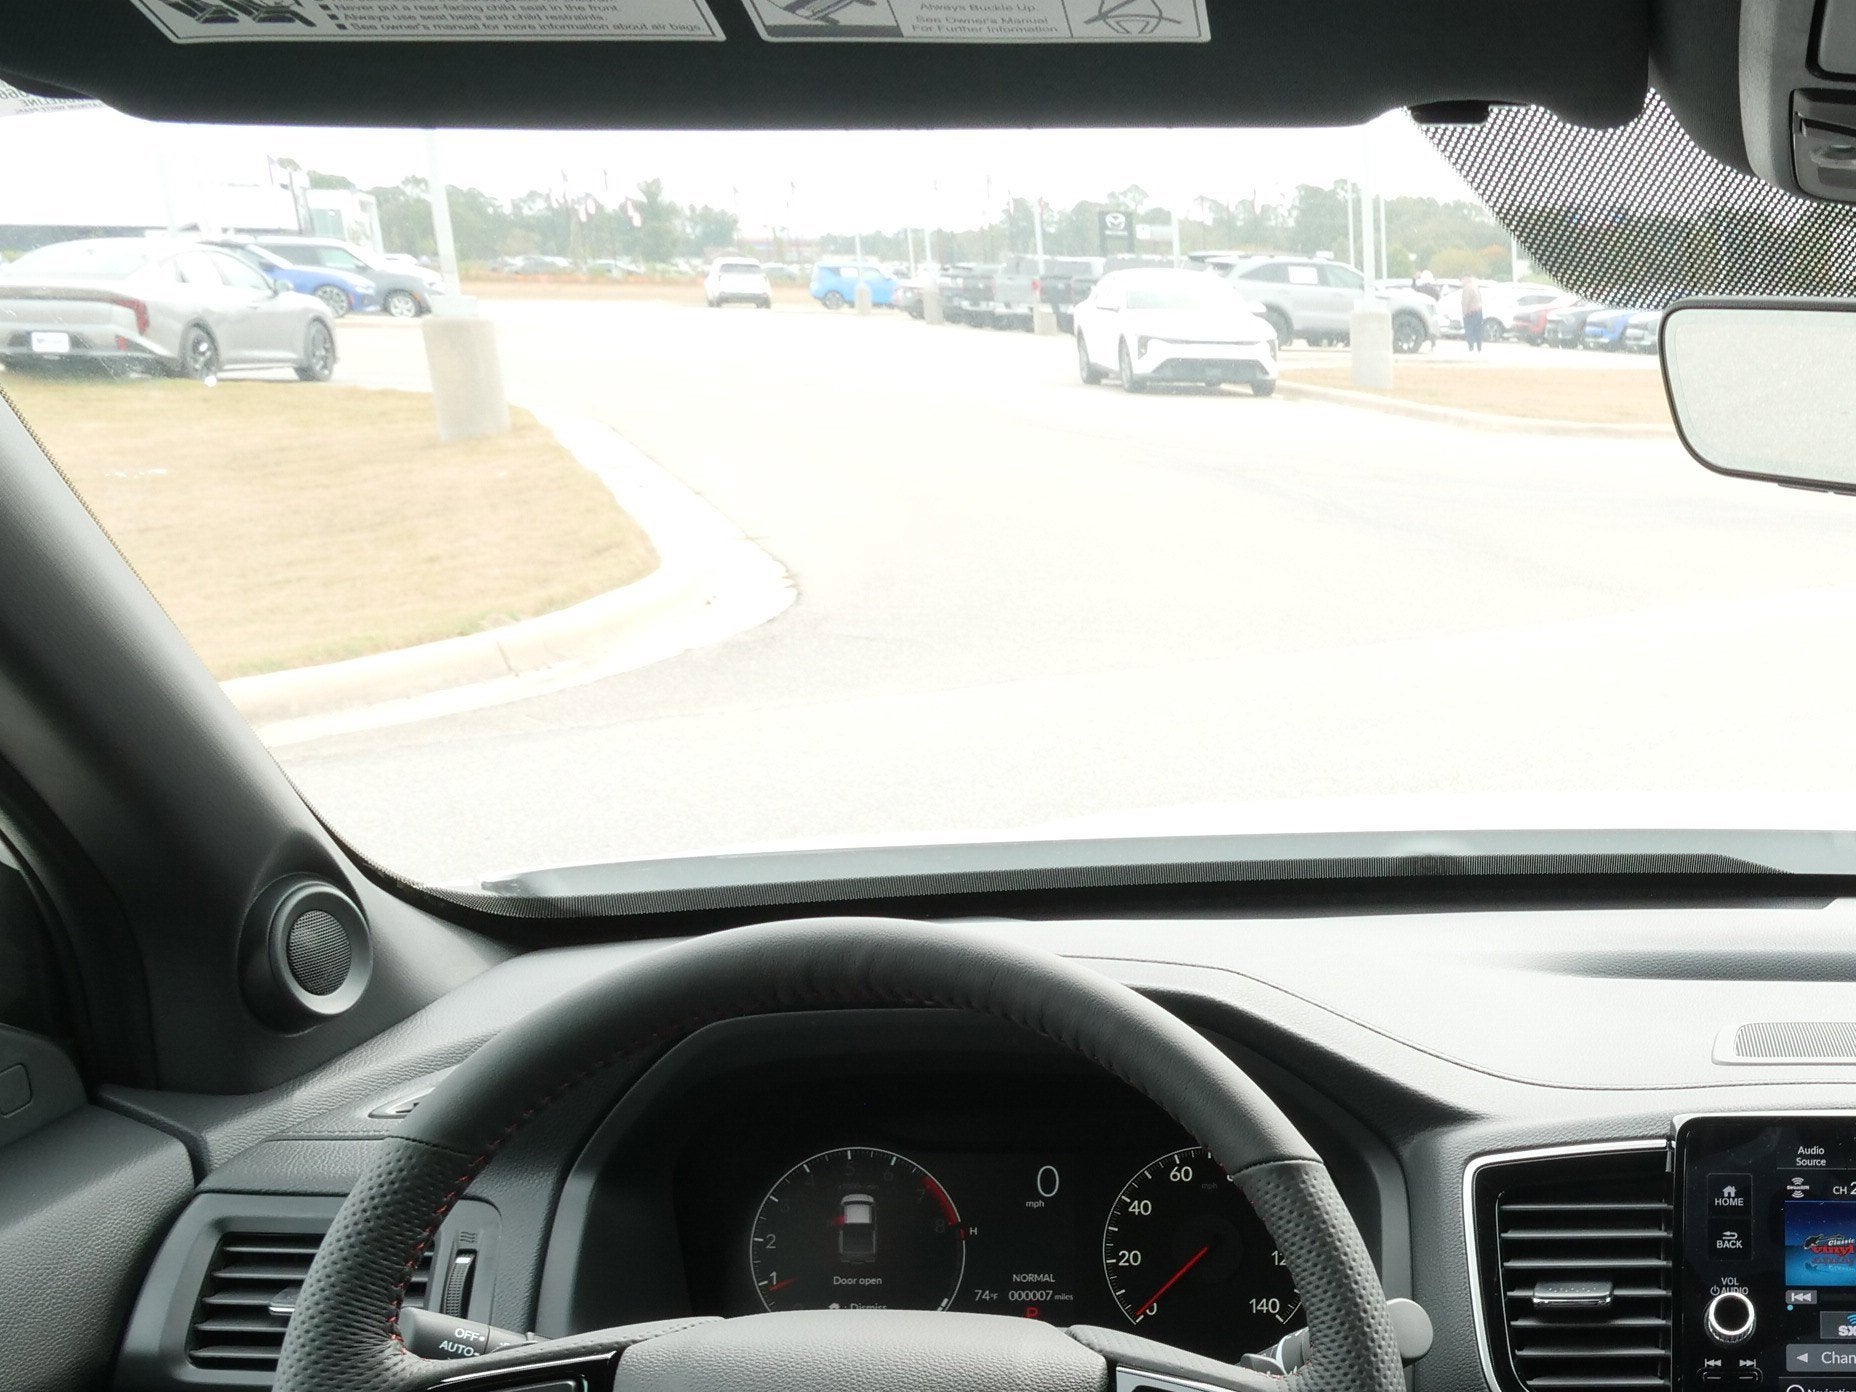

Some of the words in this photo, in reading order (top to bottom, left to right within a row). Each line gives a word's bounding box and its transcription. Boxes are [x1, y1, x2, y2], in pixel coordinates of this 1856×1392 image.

[1798, 1146, 1825, 1156] Audio
[1796, 1157, 1826, 1166] Source
[1170, 1166, 1193, 1182] 60
[1037, 1165, 1060, 1198] 0
[1833, 1186, 1847, 1195] CH
[1026, 1200, 1045, 1208] mph
[1715, 1198, 1744, 1206] HOME
[1128, 1200, 1152, 1216] 40
[970, 1227, 978, 1236] H
[766, 1234, 776, 1249] 2
[1716, 1240, 1742, 1248] BACK
[1118, 1250, 1142, 1266] 20
[770, 1272, 777, 1284] 1
[834, 1276, 856, 1285] Door
[859, 1278, 882, 1288] open
[1012, 1274, 1056, 1282] NORMAL
[1721, 1277, 1740, 1286] VOL
[1008, 1290, 1053, 1300] 000007
[1721, 1287, 1749, 1296] AUDIO
[1250, 1298, 1280, 1314] 140
[455, 1328, 479, 1342] OFF
[439, 1340, 474, 1357] AUTO
